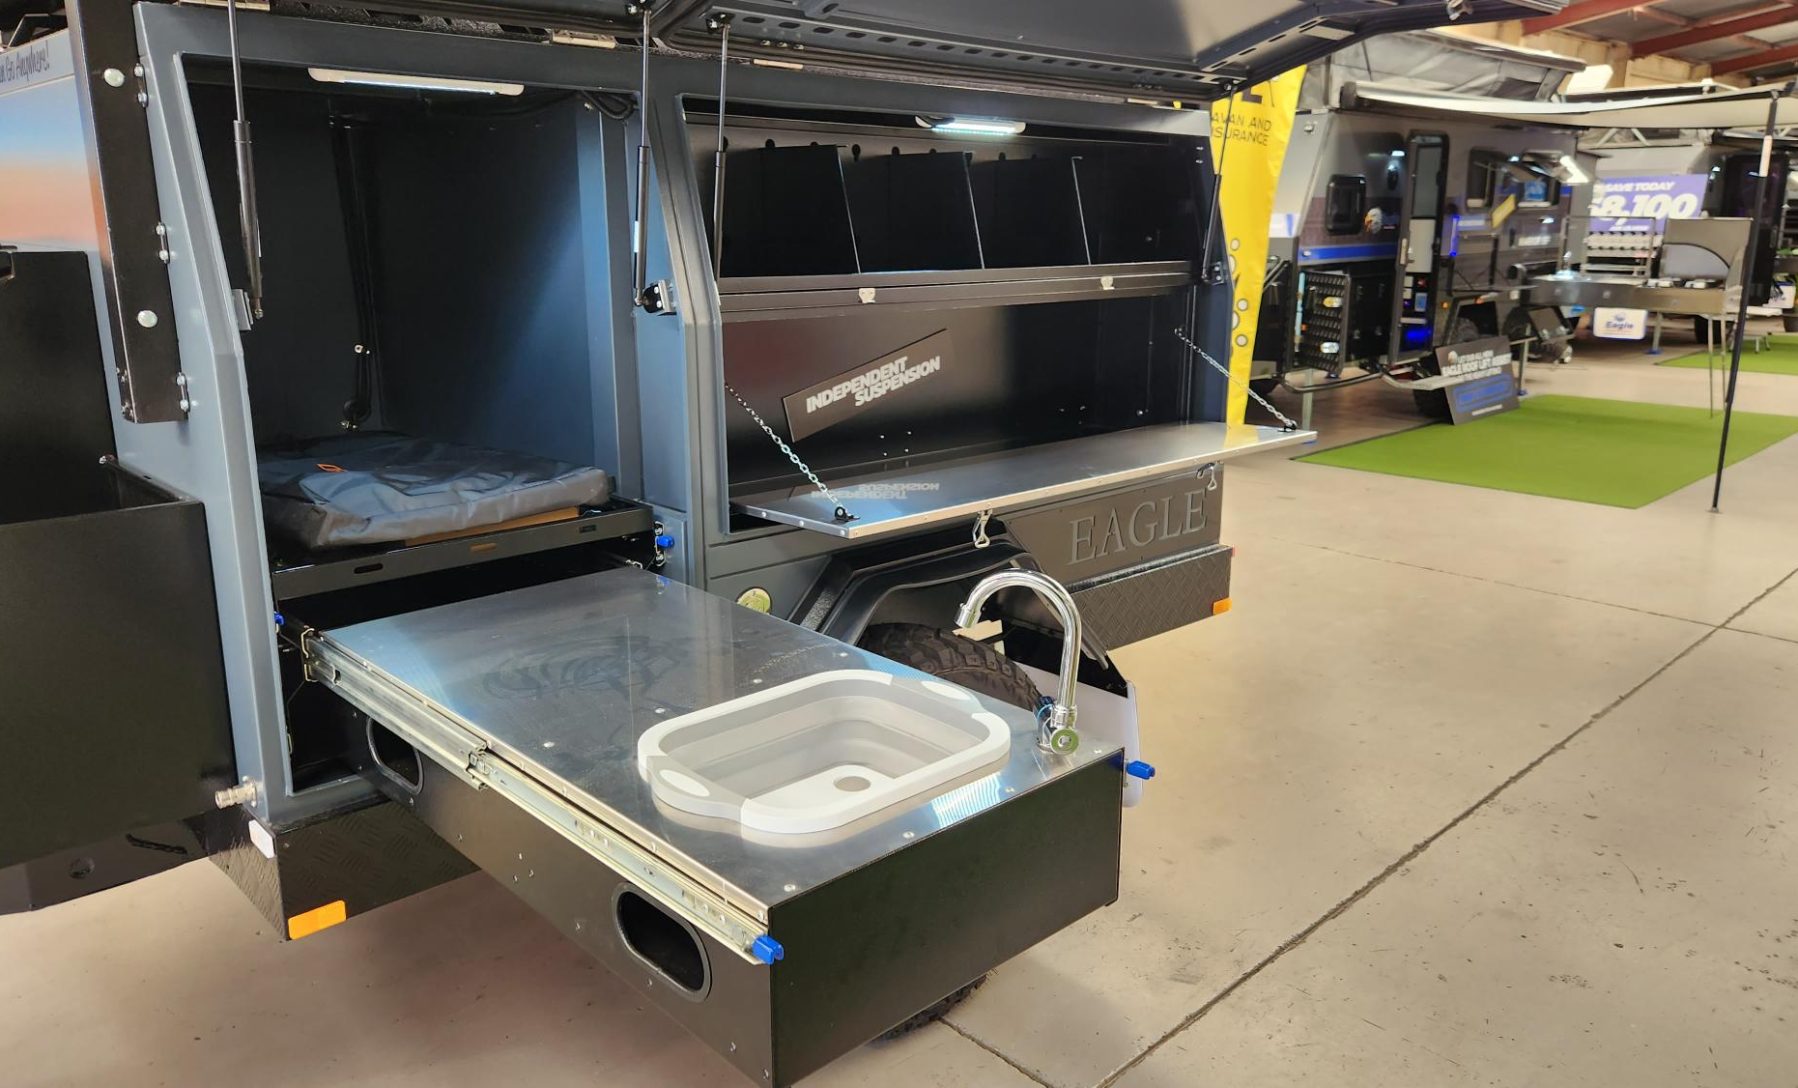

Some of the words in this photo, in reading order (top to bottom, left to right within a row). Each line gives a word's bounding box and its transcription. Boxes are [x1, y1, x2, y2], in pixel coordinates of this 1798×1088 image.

[1210, 112, 1244, 126] AVAN
[1249, 117, 1272, 132] AND
[1211, 126, 1269, 146] SURANCE
[1635, 181, 1674, 191] TODAY
[806, 356, 908, 414] INDEPENDENT
[855, 355, 941, 407] SUSPENSION
[1067, 488, 1208, 565] EAGLE
